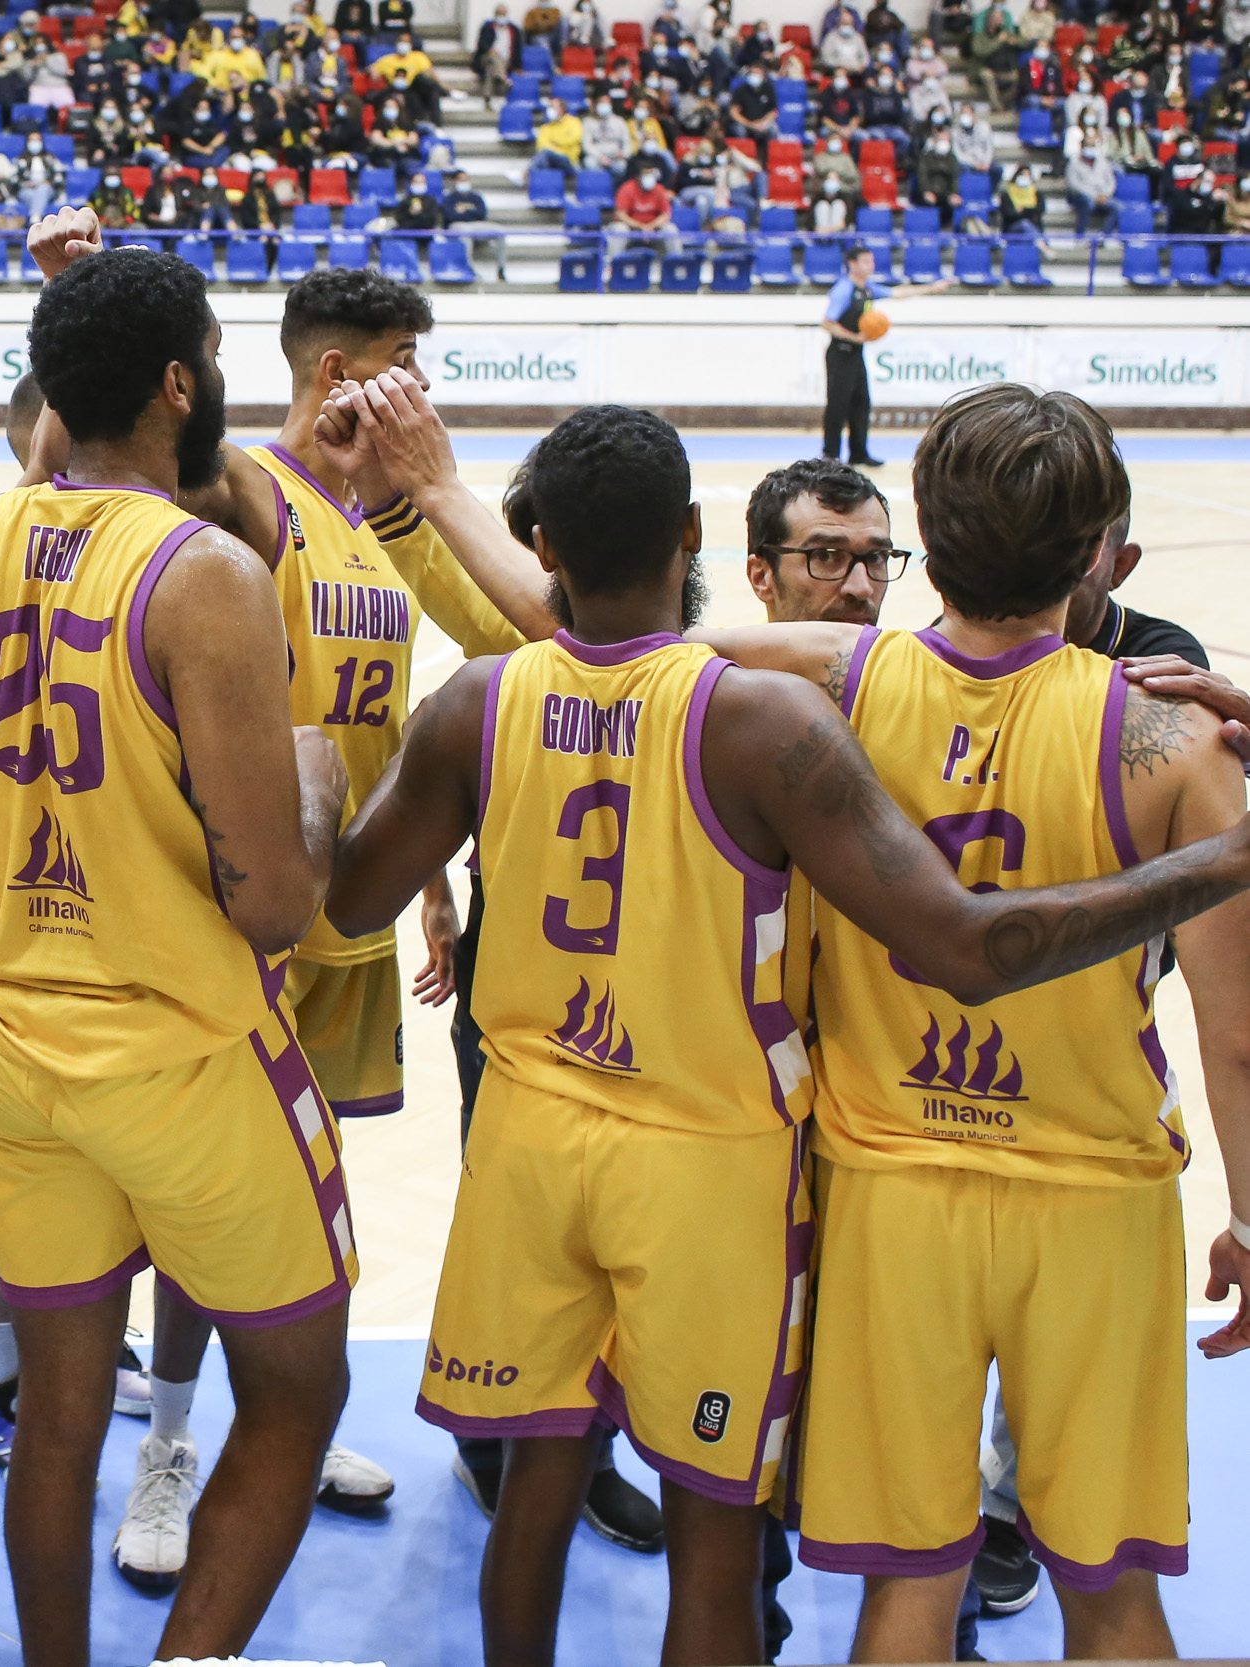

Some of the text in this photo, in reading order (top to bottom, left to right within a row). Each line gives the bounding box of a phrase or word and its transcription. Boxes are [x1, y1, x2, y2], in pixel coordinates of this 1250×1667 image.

[443, 350, 577, 381] Simoldes
[875, 351, 1006, 383] Simoldes
[1087, 353, 1217, 385] Simoldes
[344, 562, 378, 572] DHIKA
[311, 581, 409, 644] ILLIABUM
[323, 656, 395, 727] 12
[542, 778, 631, 956] 3
[923, 1127, 1018, 1144] Câmara Municipal
[445, 1357, 519, 1387] prio
